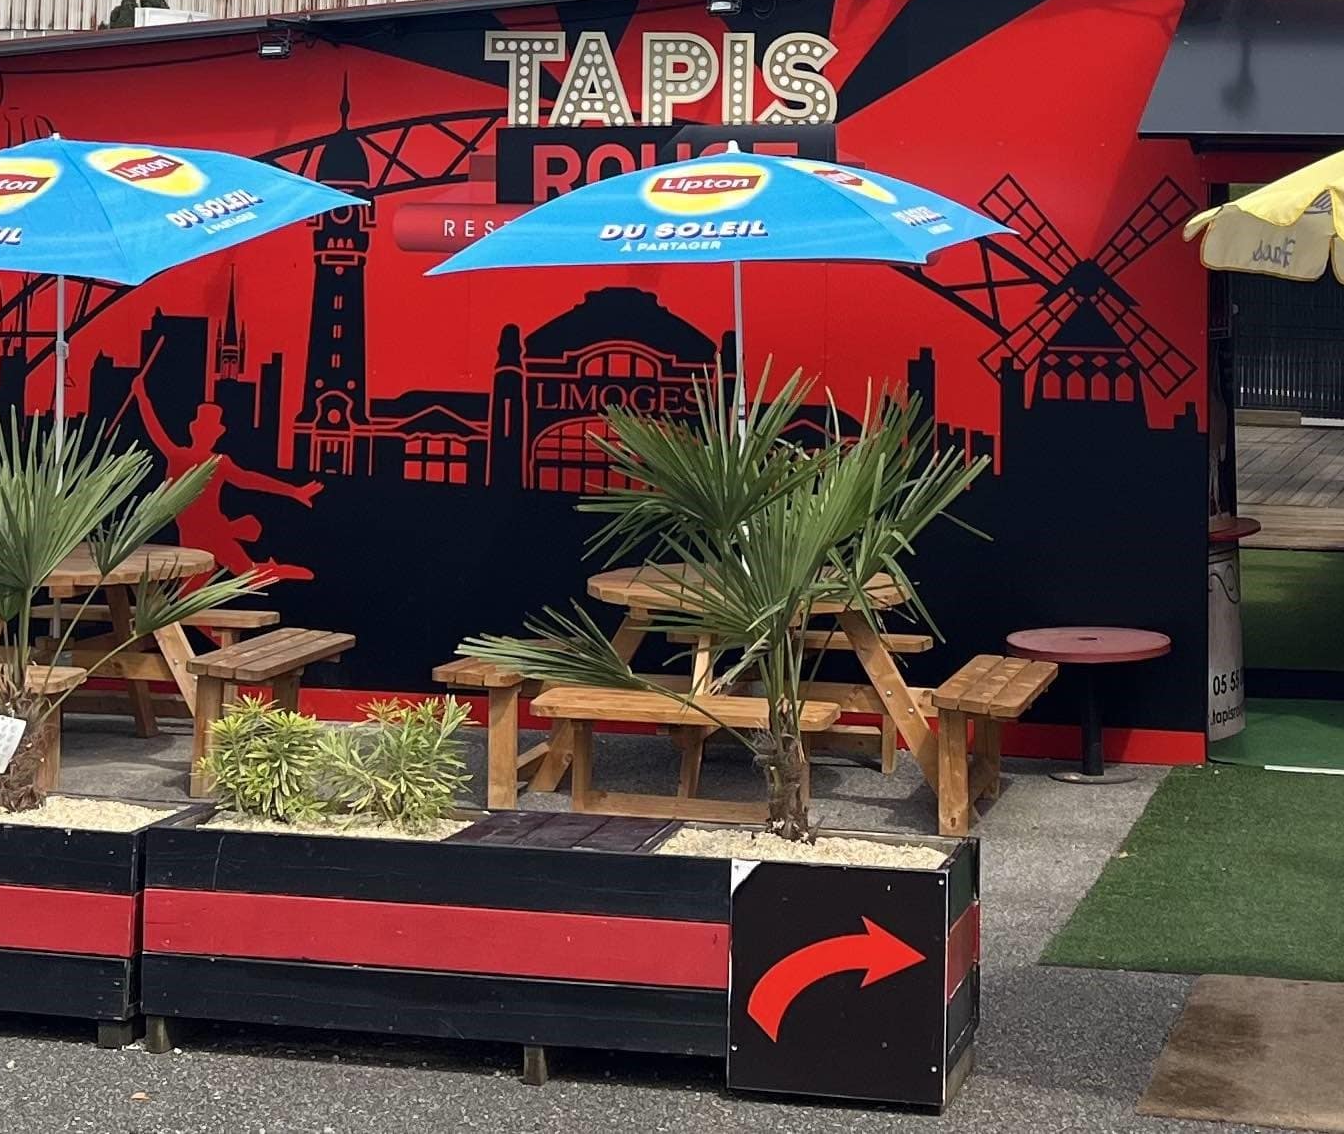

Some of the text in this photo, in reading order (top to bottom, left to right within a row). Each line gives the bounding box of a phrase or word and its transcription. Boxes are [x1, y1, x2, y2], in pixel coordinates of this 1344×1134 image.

[485, 31, 839, 127] TAPIS
[114, 158, 175, 178] Lipton
[662, 177, 750, 192] Lipton
[600, 220, 768, 241] DU SOLEIL
[620, 241, 722, 252] À PARTAGER
[536, 382, 706, 415] LIMOGES
[1213, 673, 1227, 696] 05
